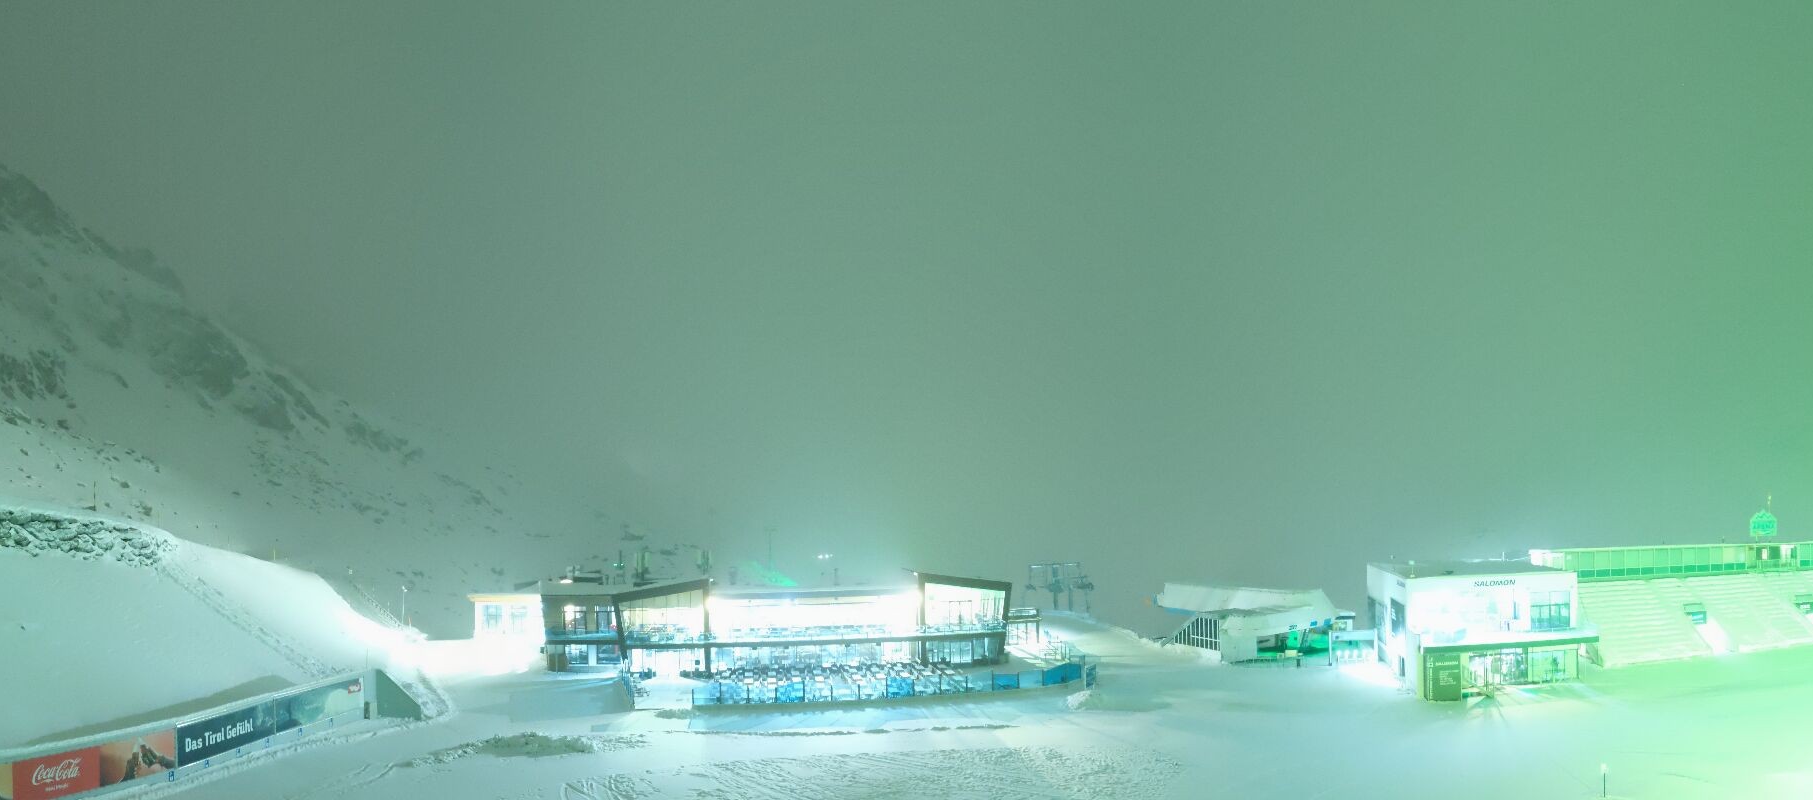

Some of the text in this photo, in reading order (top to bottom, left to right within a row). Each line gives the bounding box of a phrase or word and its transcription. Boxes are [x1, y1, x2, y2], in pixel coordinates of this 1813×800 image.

[1474, 579, 1516, 587] SALOMON
[185, 718, 254, 753] Das Tirol Gefühl
